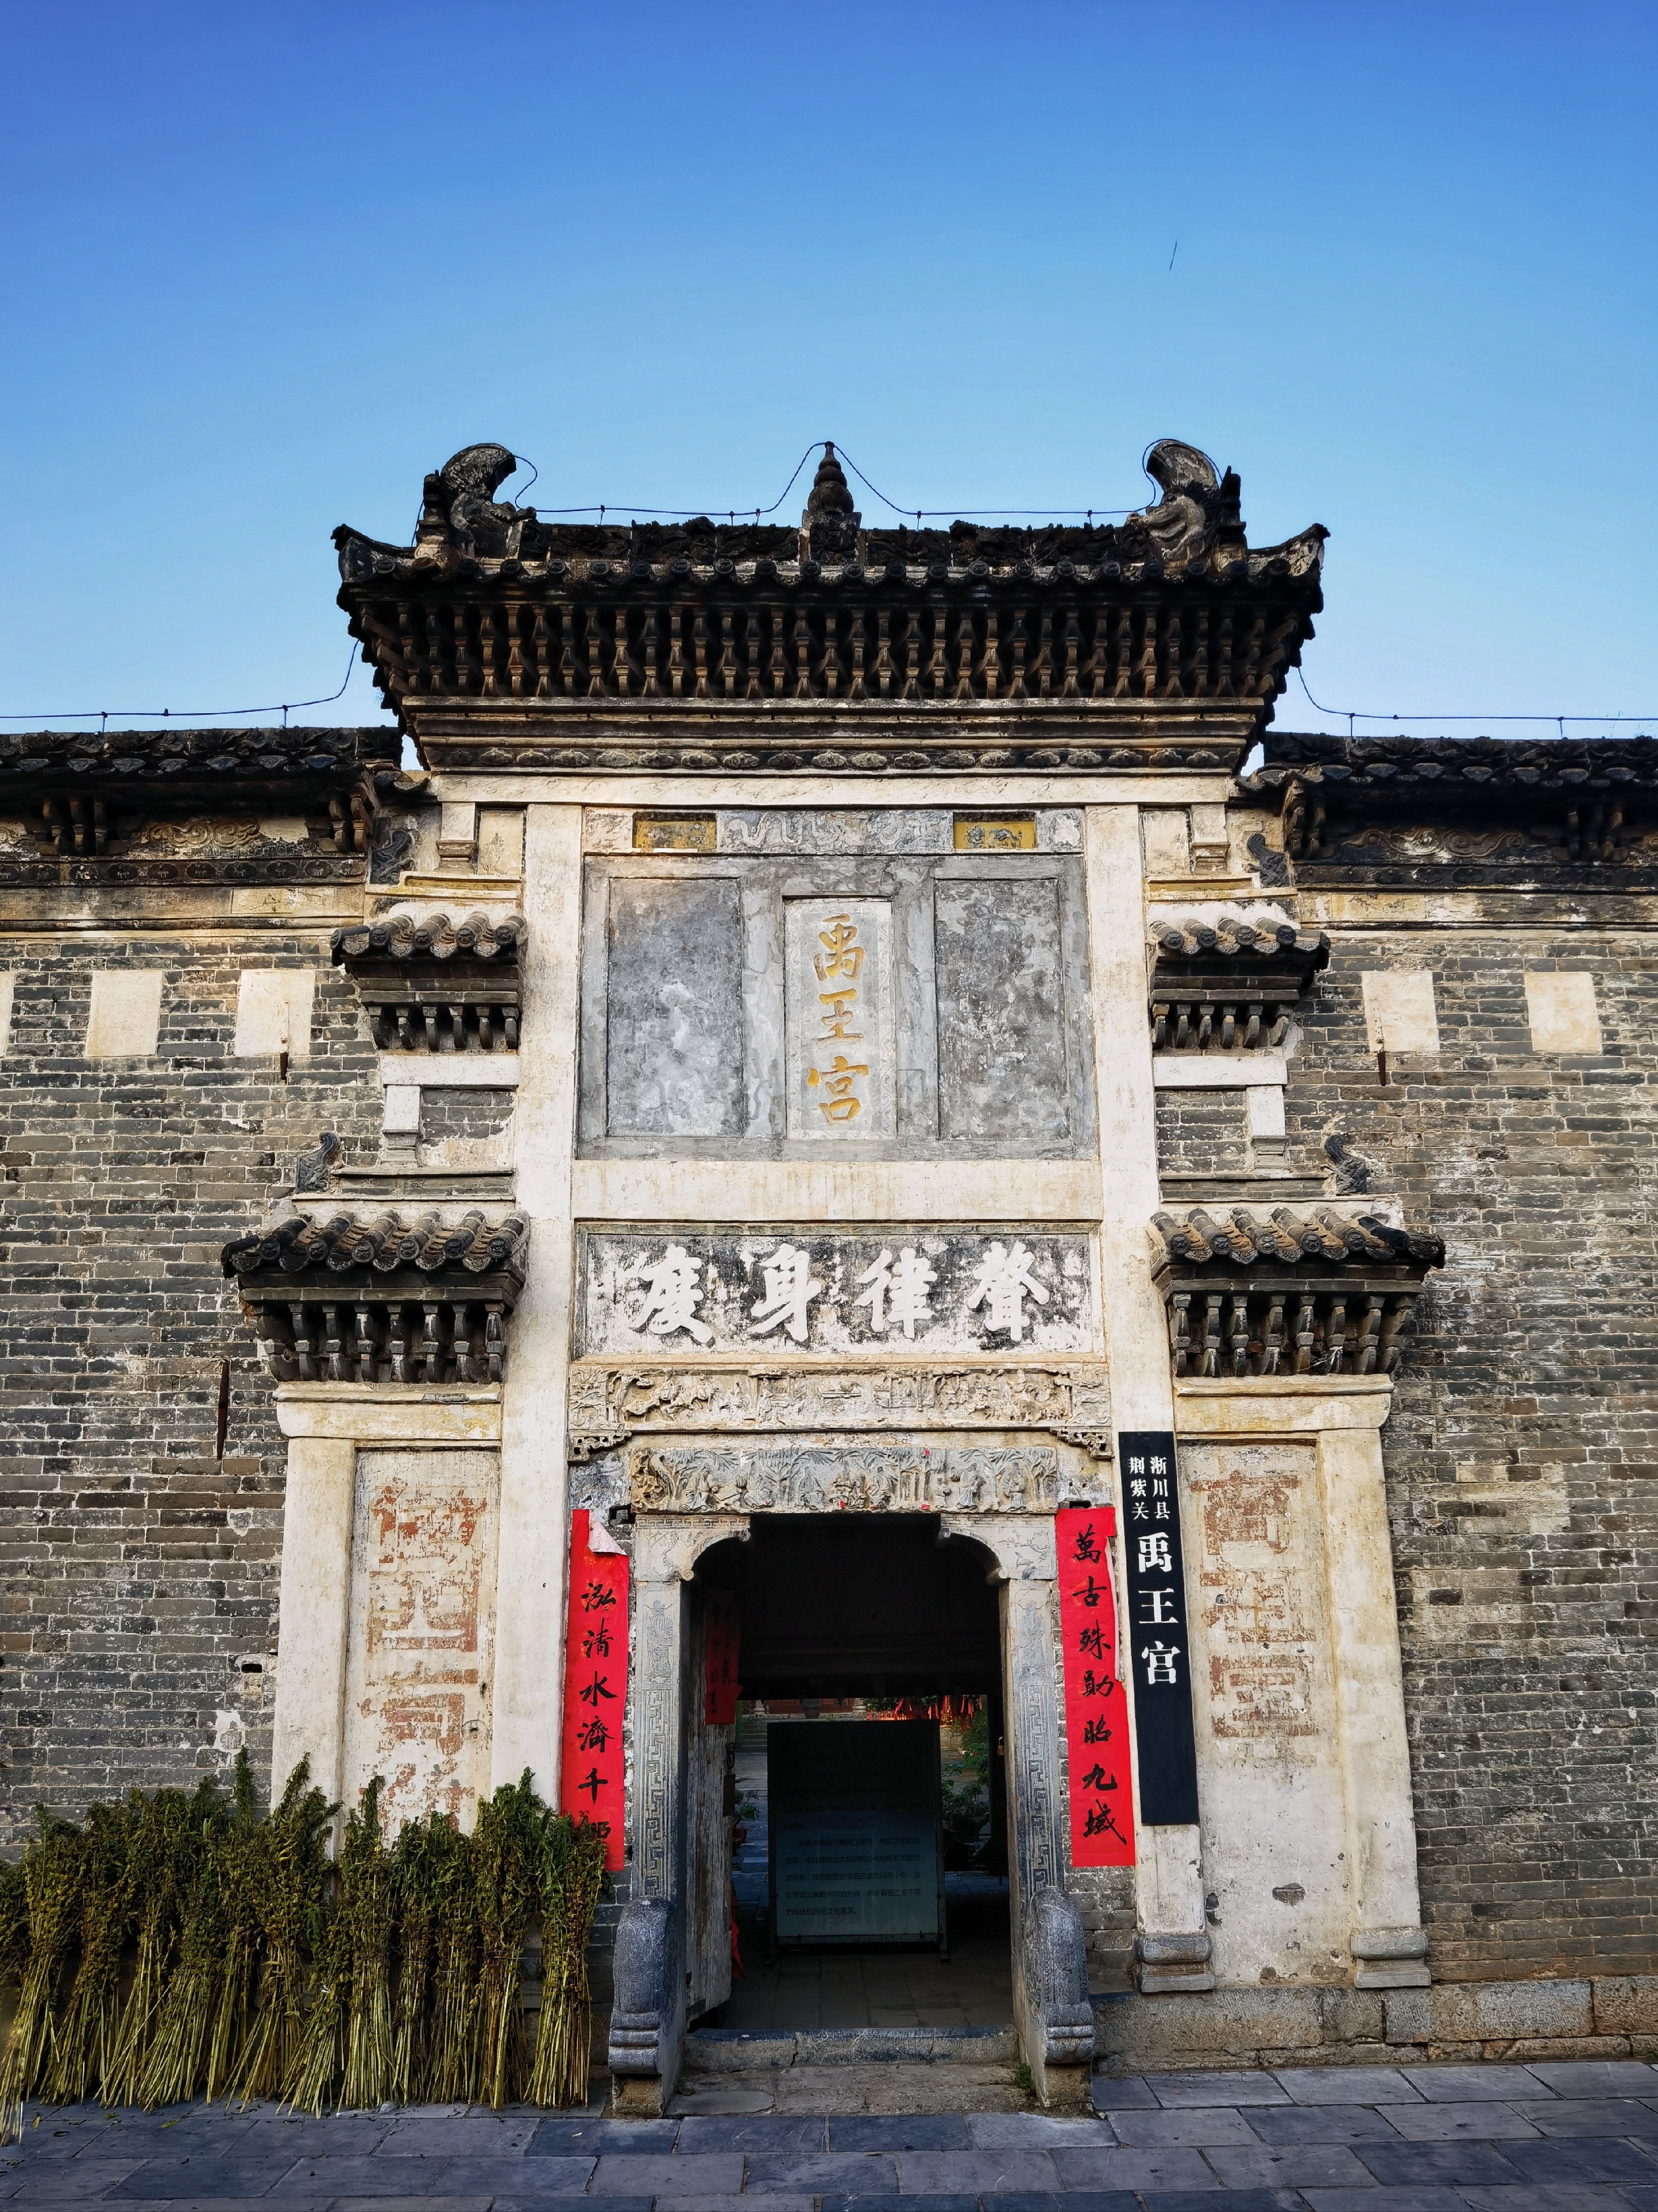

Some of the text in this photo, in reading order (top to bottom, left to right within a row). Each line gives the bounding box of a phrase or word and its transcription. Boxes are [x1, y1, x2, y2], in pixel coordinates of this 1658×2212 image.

[1127, 1456, 1149, 1520] 荆紫关
[1149, 1455, 1171, 1520] 淅川县
[1138, 1531, 1182, 1685] 禹王宫
